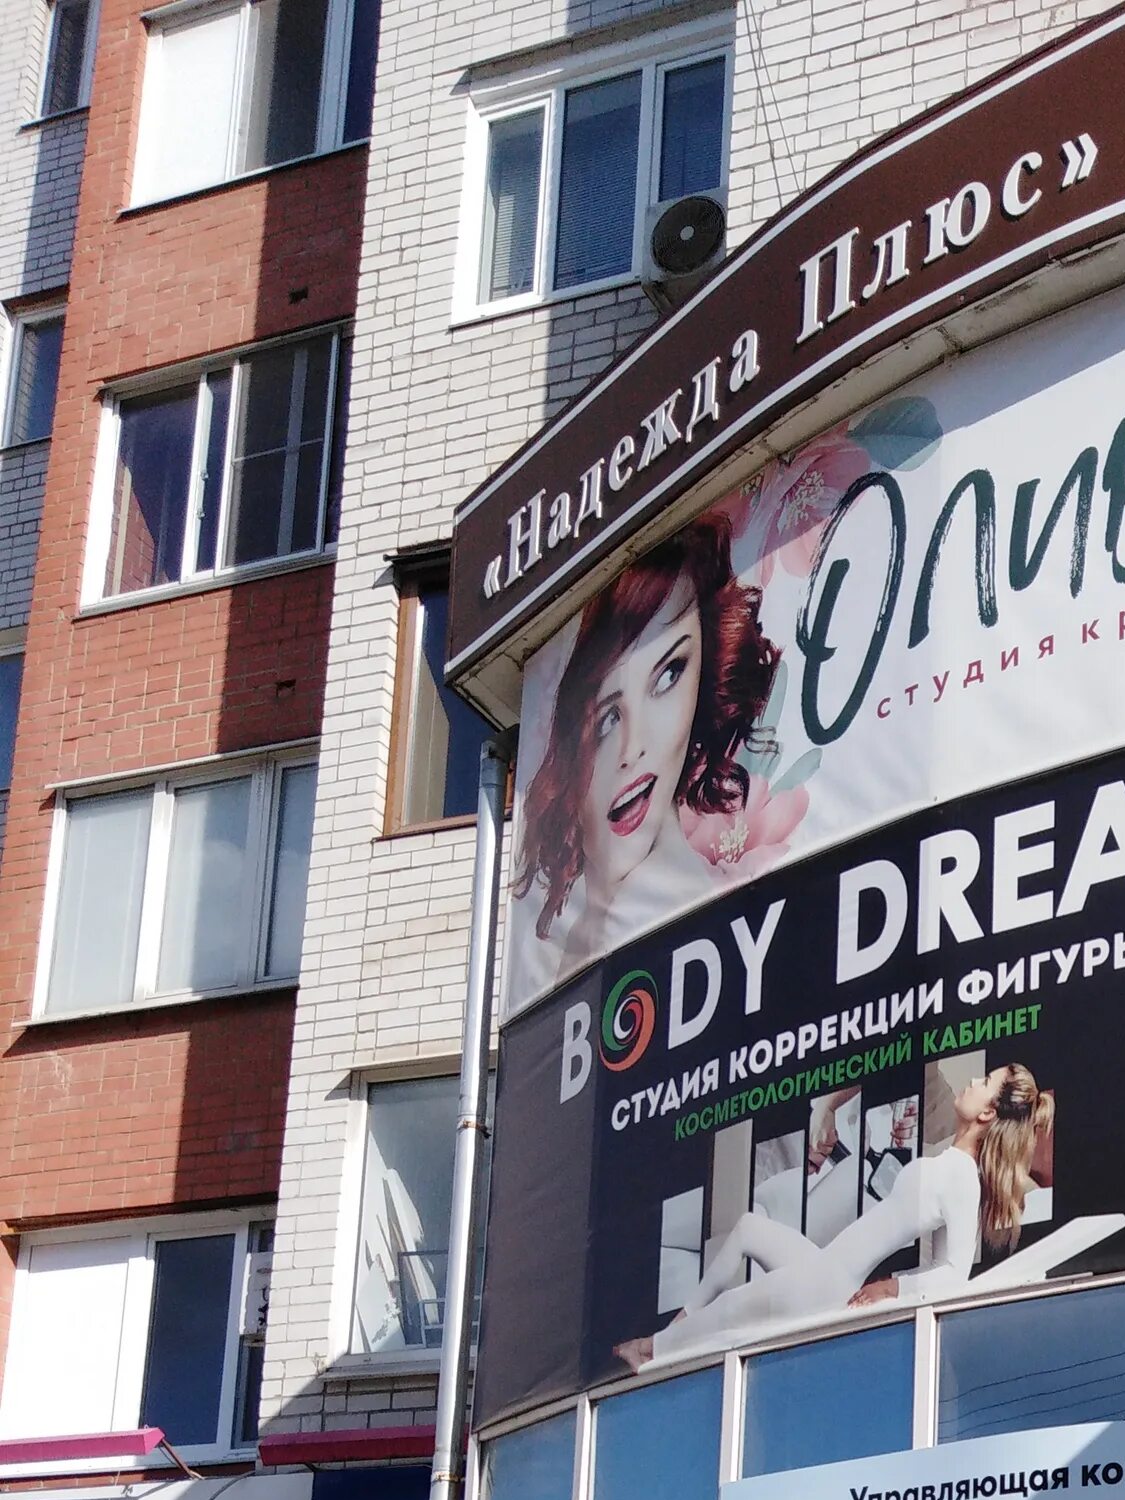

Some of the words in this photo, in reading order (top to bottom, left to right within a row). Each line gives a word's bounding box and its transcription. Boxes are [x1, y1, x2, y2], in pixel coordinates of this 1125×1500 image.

[483, 329, 761, 599] «Надежда
[797, 133, 1098, 344] Плюс»
[876, 634, 1057, 719] студия
[560, 899, 786, 1104] BODY
[611, 1058, 720, 1131] СТУДИЯ
[729, 978, 943, 1084] КОРРЕКЦИИ
[674, 1033, 912, 1141] КОСМЕТОЛОГИЧЕСКИЙ
[923, 1004, 1042, 1056] КАБИНЕТ
